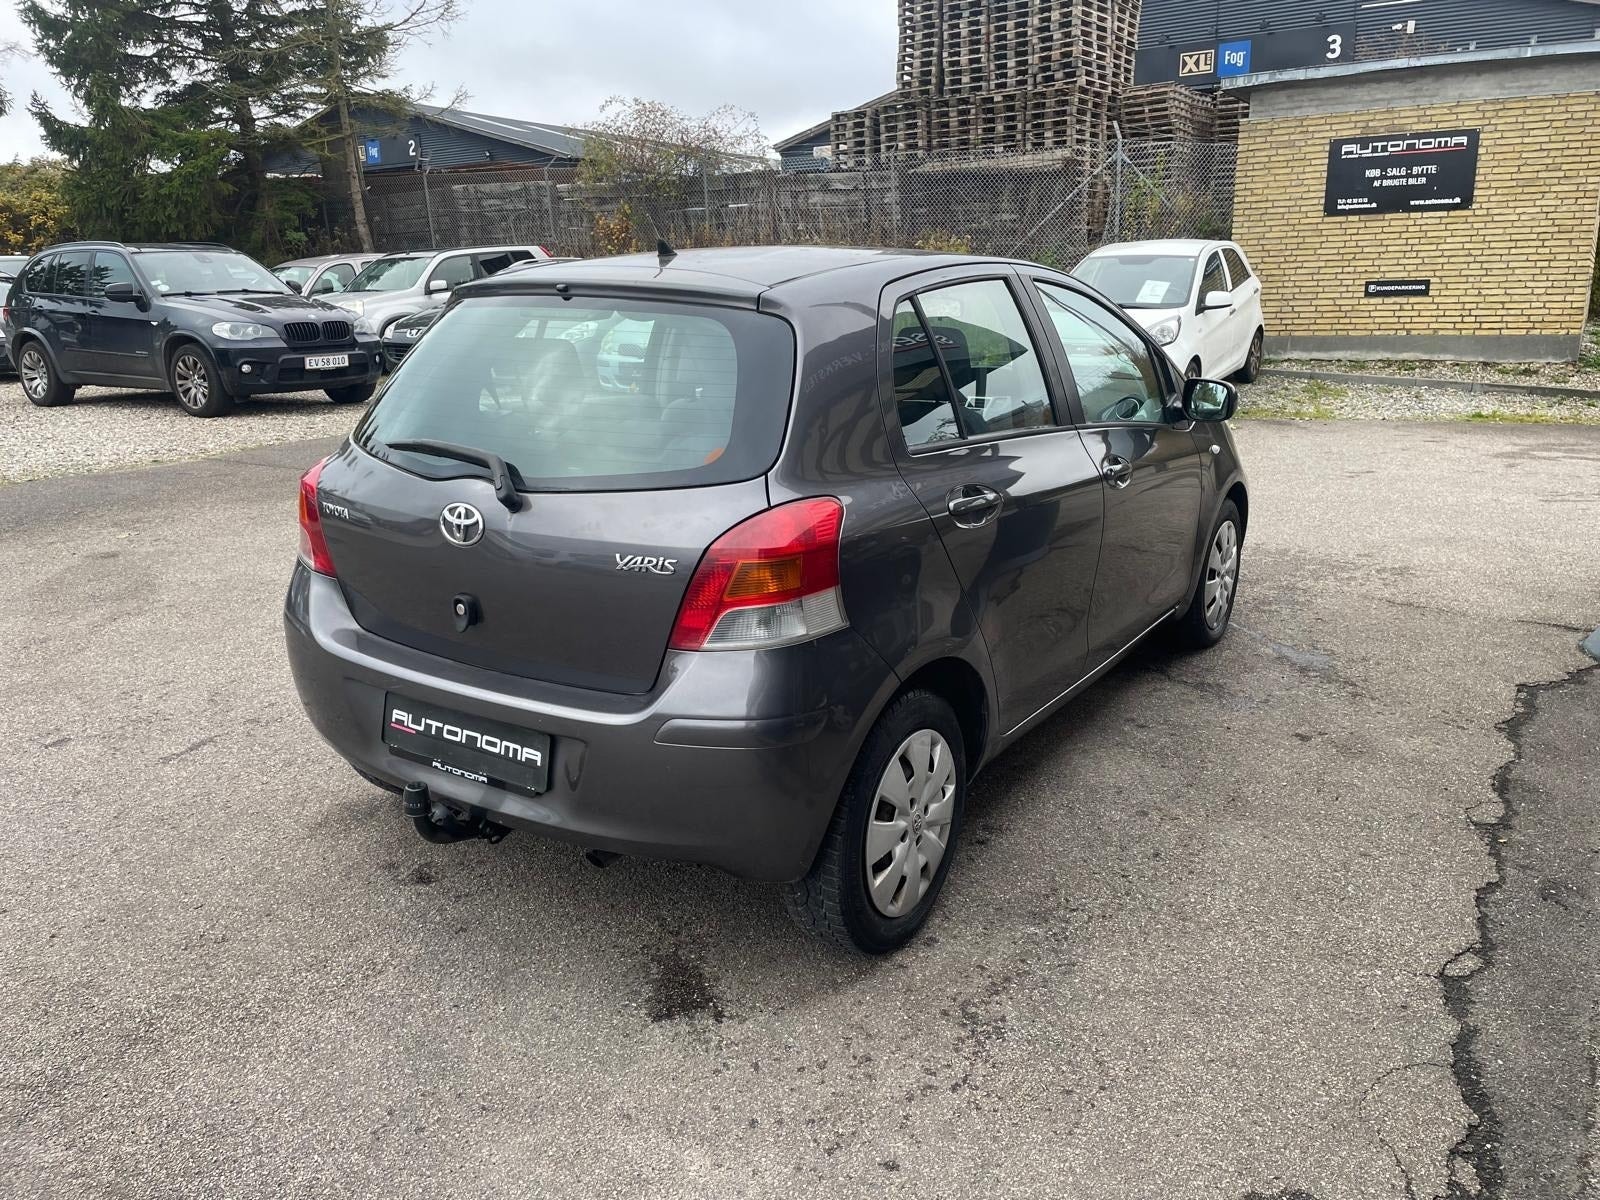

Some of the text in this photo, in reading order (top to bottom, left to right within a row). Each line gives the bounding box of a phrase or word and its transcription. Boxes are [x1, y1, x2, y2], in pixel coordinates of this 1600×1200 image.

[1325, 34, 1342, 59] 3
[1182, 53, 1211, 73] XL
[1224, 50, 1244, 67] Fog
[408, 139, 416, 156] 2
[1341, 136, 1467, 154] AUTONOMA
[1365, 168, 1380, 178] KØB
[1386, 167, 1406, 176] SALG
[1412, 165, 1437, 175] BYTTE
[1373, 177, 1427, 187] AF BRUGTE BILER
[308, 356, 346, 367] EV 58 010
[321, 501, 349, 519] TOYOTA
[391, 708, 542, 767] AUTONOMA
[432, 760, 488, 783] AUTONOMA
